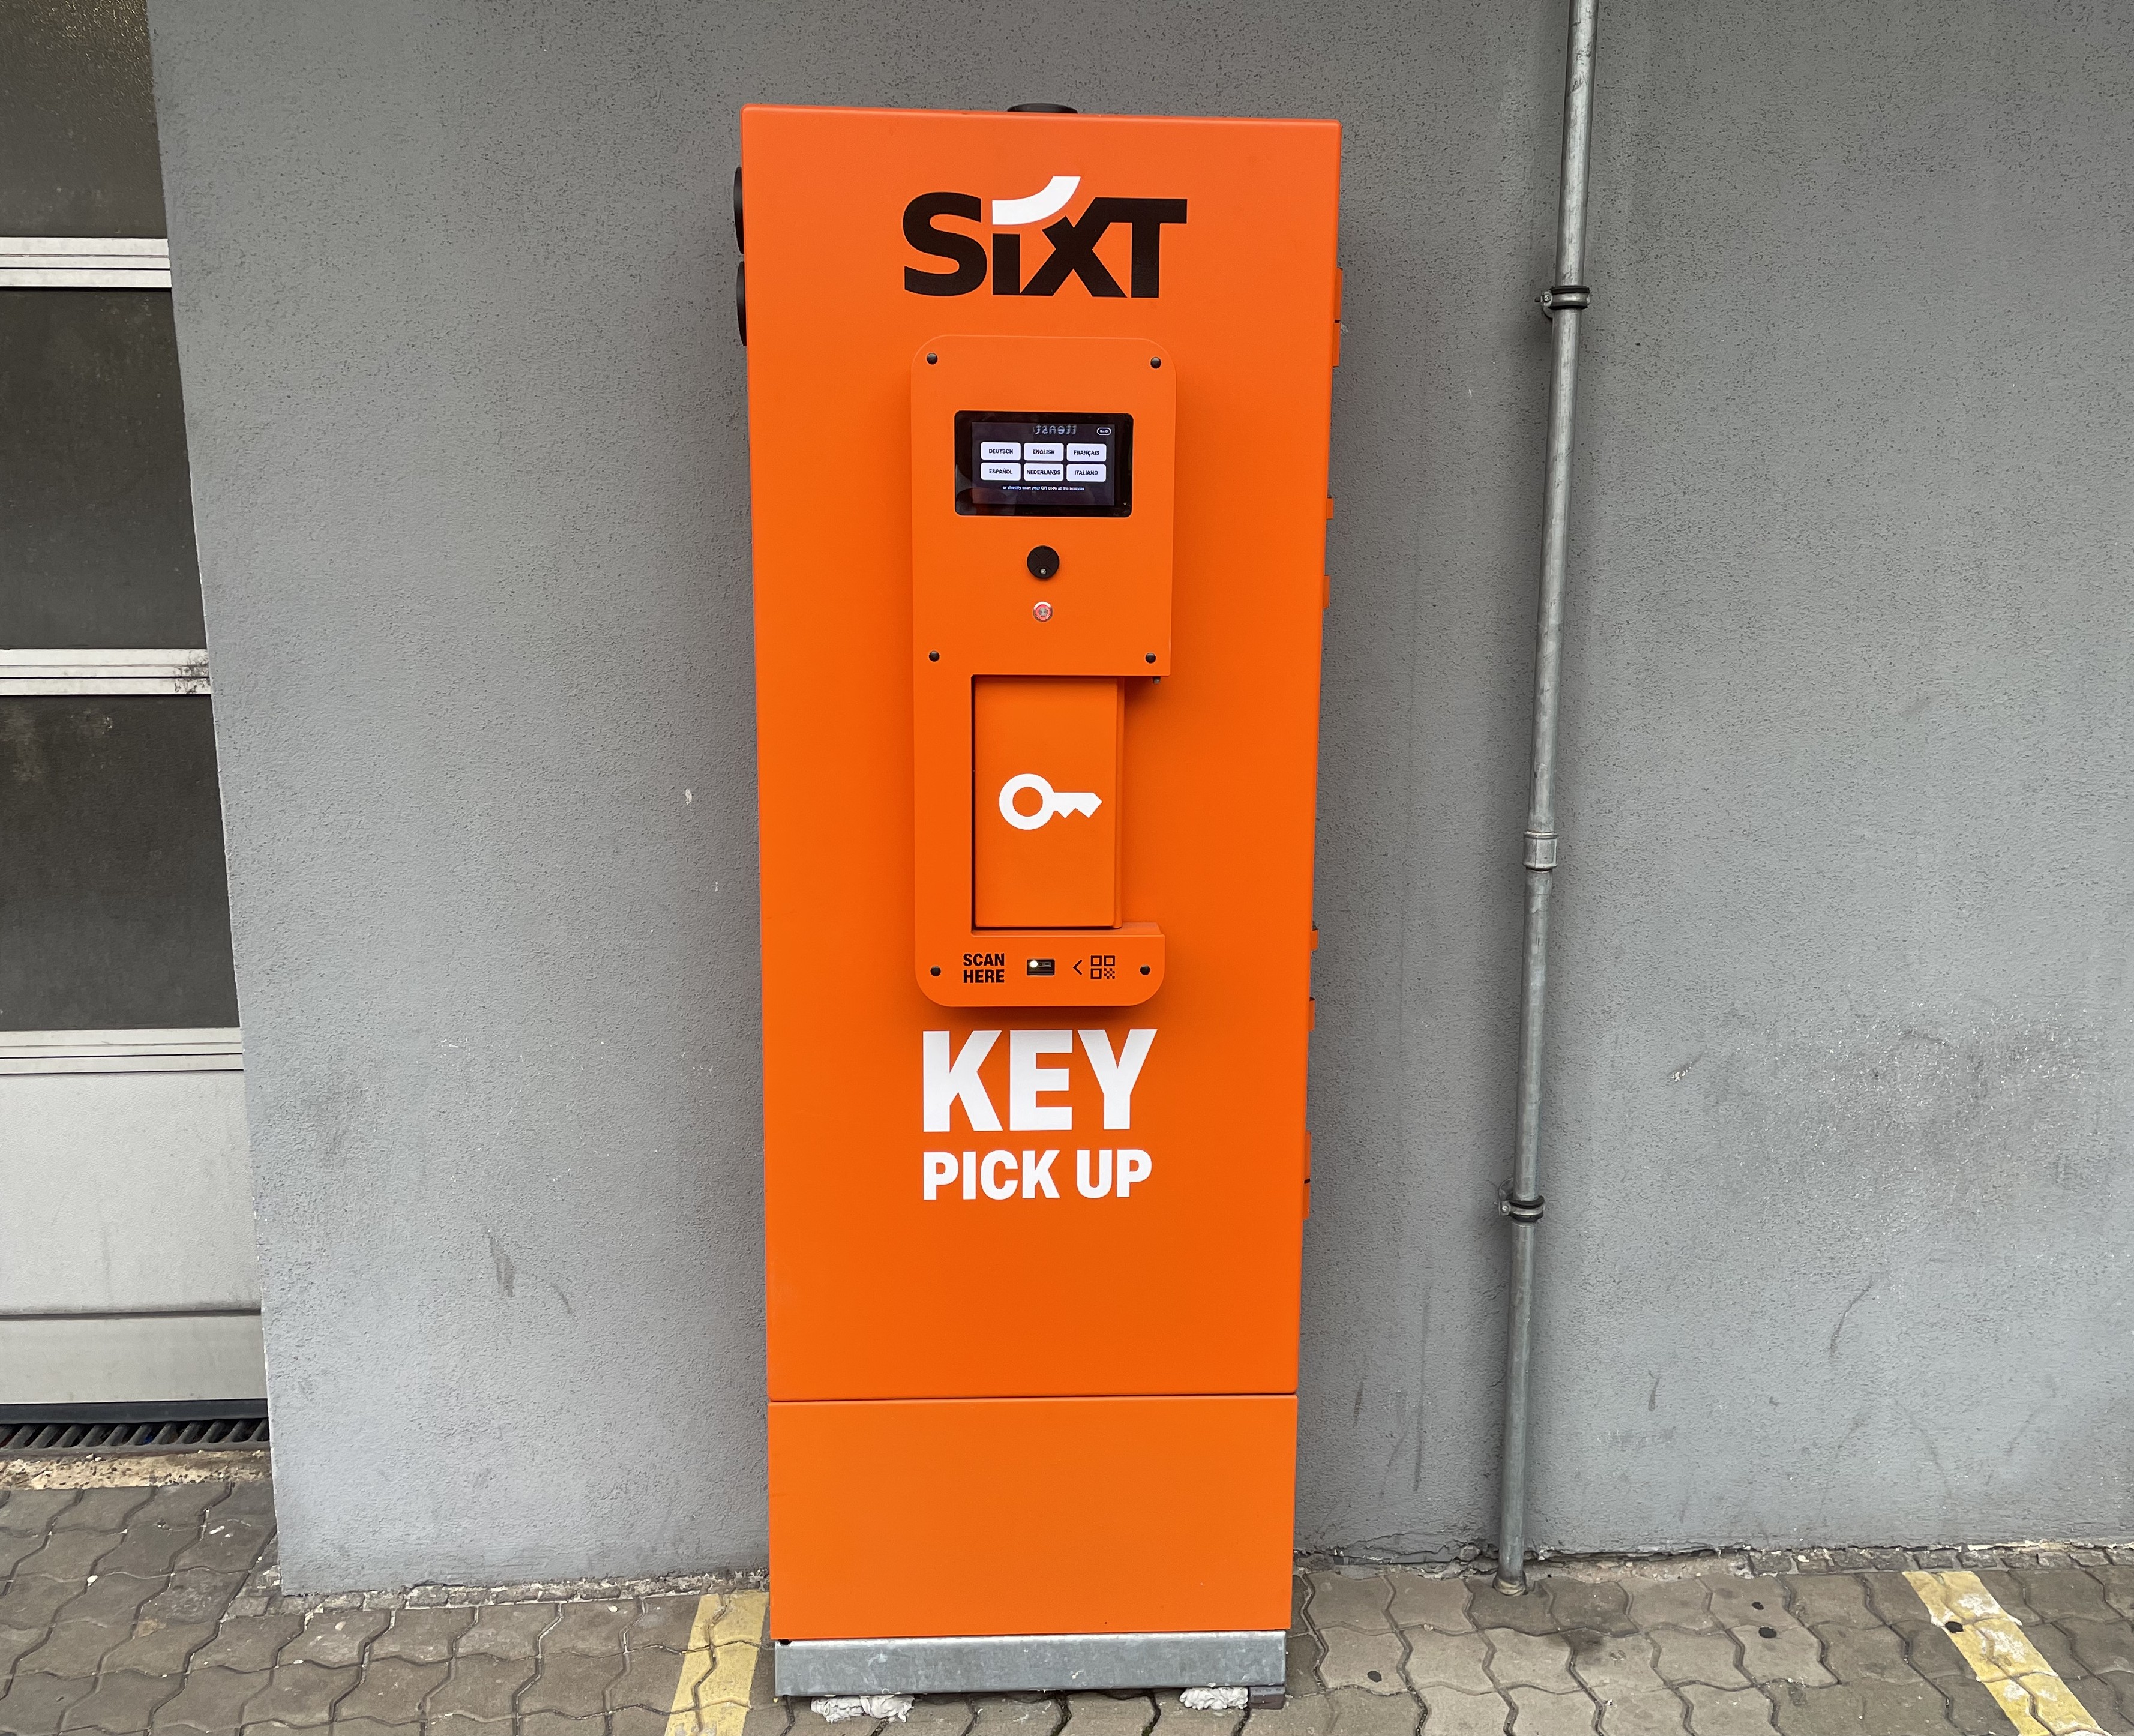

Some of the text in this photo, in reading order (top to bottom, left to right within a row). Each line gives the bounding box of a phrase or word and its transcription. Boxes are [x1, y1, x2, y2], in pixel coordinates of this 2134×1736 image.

[963, 953, 1005, 967] SCAN
[963, 969, 1005, 983] HERE
[922, 1029, 1158, 1132] KEY
[923, 1149, 1152, 1200] PICK UP
